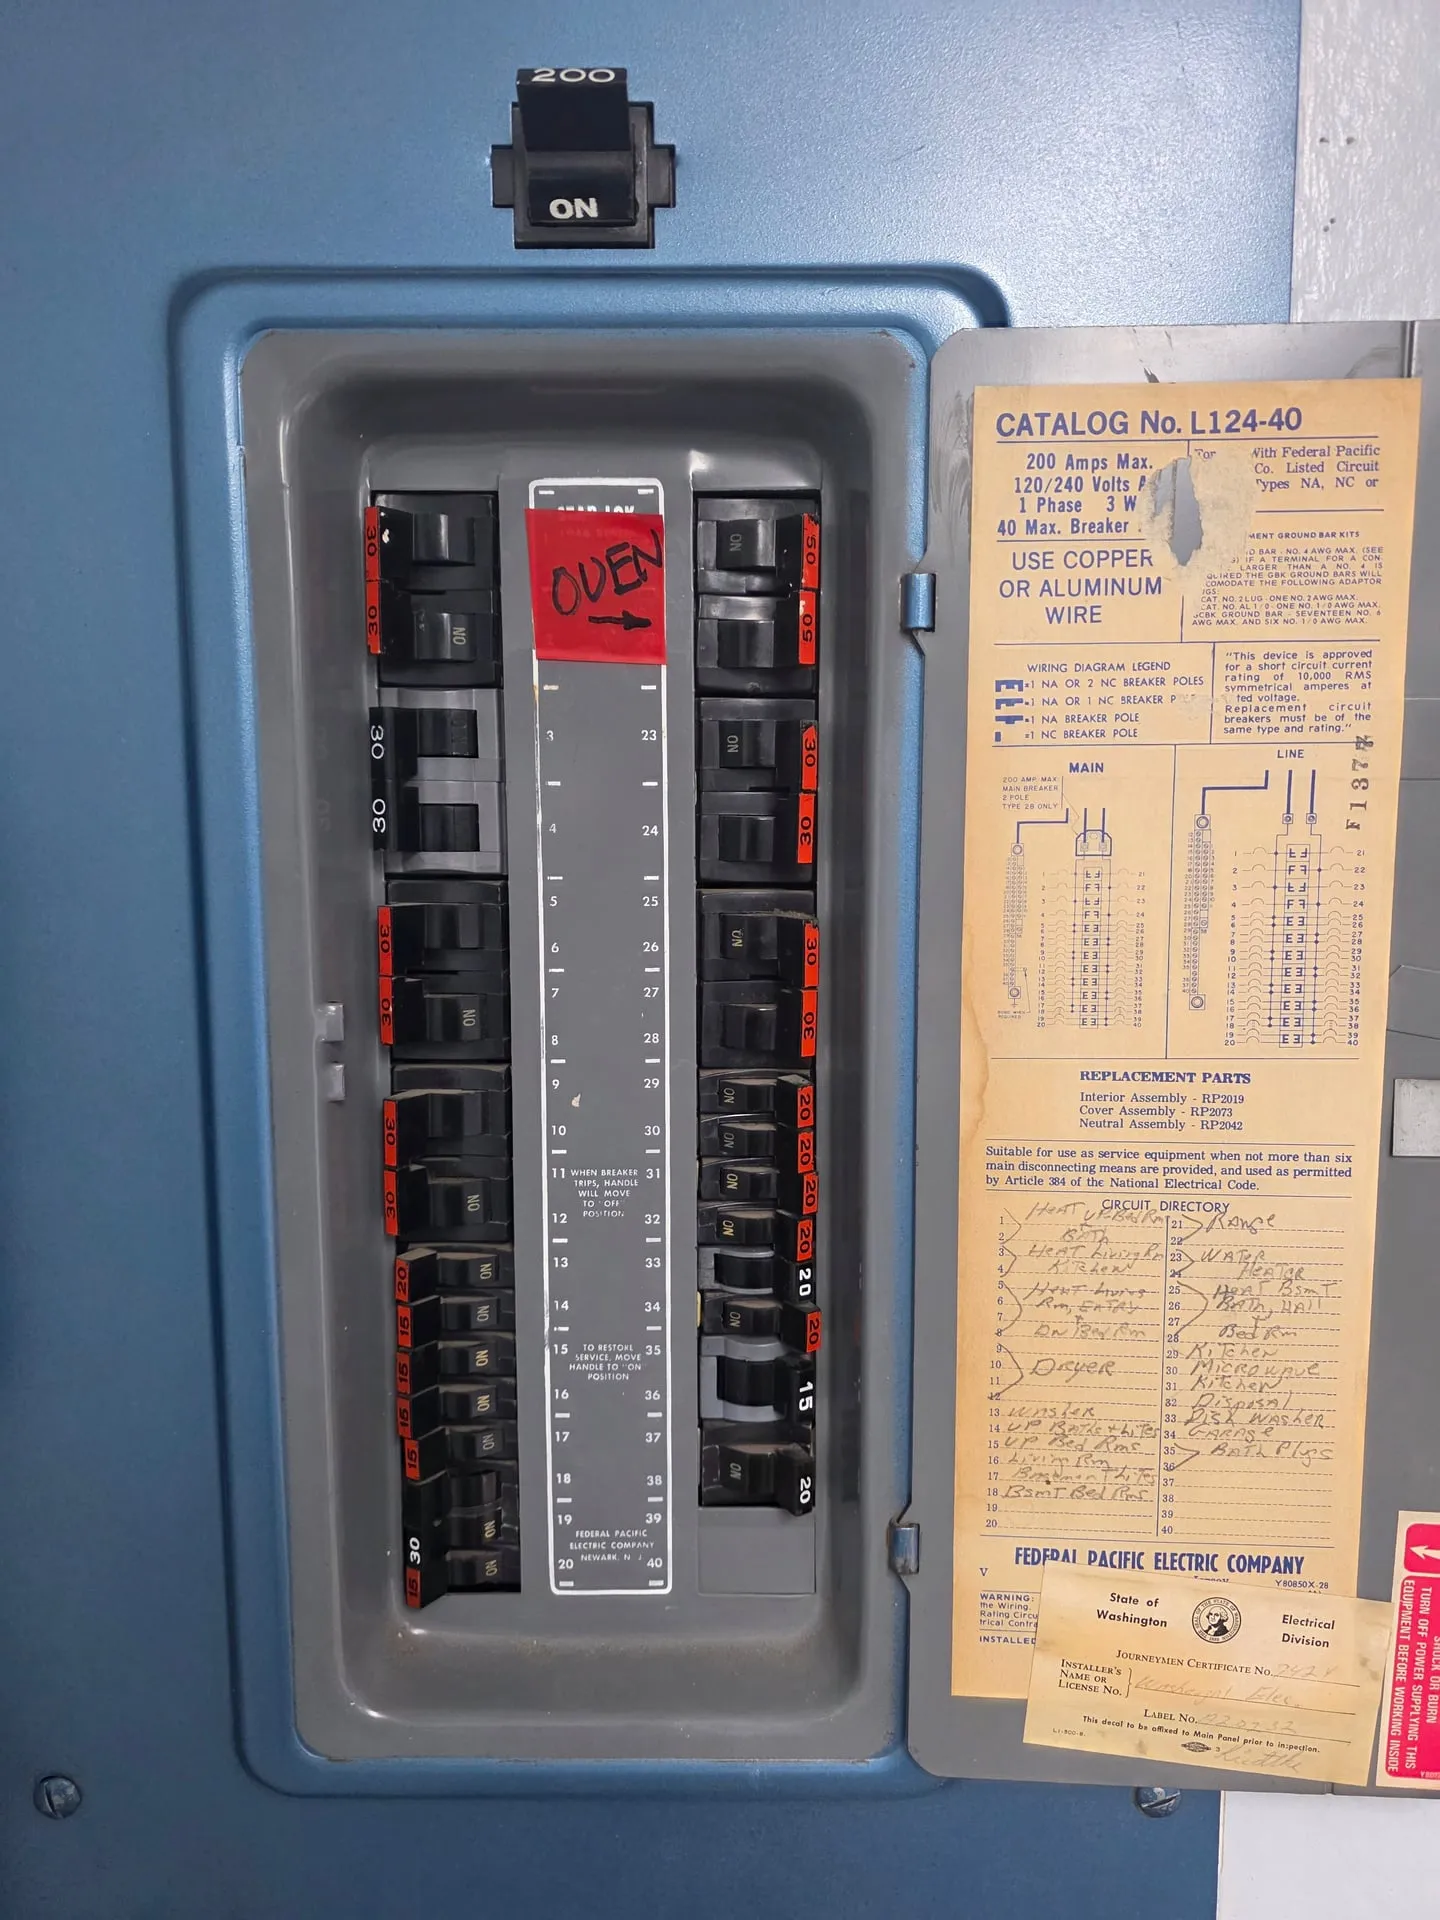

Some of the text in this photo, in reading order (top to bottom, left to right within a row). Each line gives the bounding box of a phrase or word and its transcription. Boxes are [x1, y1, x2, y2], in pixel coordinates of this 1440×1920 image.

[532, 68, 615, 82] 200
[550, 198, 598, 219] ON
[996, 407, 1302, 437] CATALOG No. L124-40
[1282, 444, 1380, 458] Federal Pacific
[1027, 453, 1153, 473] 200 Amps Max.
[1287, 461, 1379, 473] Listed Circuit
[1015, 476, 1129, 493] 120/240 Volts
[1336, 477, 1379, 487] NC or
[1037, 497, 1082, 513] Phase
[997, 518, 1129, 536] 40 Breaker
[367, 526, 376, 556] 30
[807, 536, 816, 564] 50
[1012, 549, 1153, 570] USE COPPER
[1000, 577, 1162, 598] OR ALUMINUM
[1046, 605, 1102, 624] WIRE
[803, 614, 812, 642] 50
[453, 627, 466, 645] ON
[1263, 650, 1372, 660] device approved
[1027, 662, 1170, 673] WIRING DIAGRAM LEGEND
[1291, 661, 1372, 670] circuit current
[1124, 676, 1204, 686] BREAKER POLES
[1225, 672, 1331, 682] rating 10,000
[1225, 683, 1292, 692] symmetrical
[1226, 704, 1306, 713] Replacement
[1224, 715, 1271, 723] breakers
[370, 725, 384, 759] 30
[641, 730, 657, 741] 23
[727, 735, 739, 752] ON
[805, 738, 816, 767] 30
[1277, 750, 1304, 758] LINE
[1069, 763, 1104, 773] MAIN
[372, 799, 385, 833] 30
[642, 825, 658, 836] 24
[800, 817, 811, 845] 30
[380, 925, 390, 953] 30
[806, 937, 817, 965] 30
[552, 988, 559, 998] 7
[644, 1033, 659, 1043] 28
[644, 1079, 659, 1088] 29
[1080, 1071, 1251, 1084] REPLACEMENT PARTS
[724, 1088, 735, 1103] ON
[1080, 1092, 1244, 1105] Interior Assembly RP2019
[800, 1094, 810, 1117] 20
[1080, 1106, 1232, 1117] Cover RP2073
[552, 1126, 566, 1135] 10
[1080, 1119, 1243, 1130] Neutral RP2042
[986, 1146, 1205, 1161] Suitable service equipment
[1018, 1162, 1352, 1178] disconnecting permitted
[574, 1180, 599, 1188] TRIPS,
[1005, 1176, 1259, 1190] Article 384 National Electrical Code.
[805, 1180, 815, 1206] 20
[1102, 1200, 1230, 1212] CIRCUIT DIRECTORY
[552, 1213, 567, 1223] 12
[645, 1215, 660, 1224] 32
[1171, 1221, 1182, 1229] 21
[800, 1227, 810, 1253] 20
[480, 1263, 491, 1279] ON
[398, 1269, 406, 1292] 20
[799, 1269, 811, 1296] 20
[645, 1302, 660, 1312] 34
[554, 1389, 569, 1399] 16
[799, 1381, 812, 1410] 15
[1165, 1414, 1176, 1422] 33
[989, 1425, 1000, 1433] 14
[408, 1448, 417, 1464] 15
[647, 1475, 662, 1486] 38
[800, 1477, 811, 1503] 20
[1163, 1495, 1174, 1503] 38
[576, 1529, 647, 1538] FEDERAL PACIFIC
[410, 1538, 420, 1564] 30
[647, 1558, 662, 1568] 40
[1015, 1547, 1304, 1574] FEDERAL PACIFIC ELECTRIC COMPANY
[980, 1593, 1034, 1602] WARNING:
[1110, 1593, 1159, 1607] State of
[1096, 1609, 1167, 1627] Washington
[1282, 1614, 1335, 1630] Electrical
[1282, 1633, 1329, 1648] Division
[1407, 1587, 1432, 1741] TURN OFF POWER SUPPLYING
[1388, 1580, 1415, 1772] EQUIPMENT BEFORE WORKING INSIDE
[1194, 1730, 1240, 1743] Main Panel
